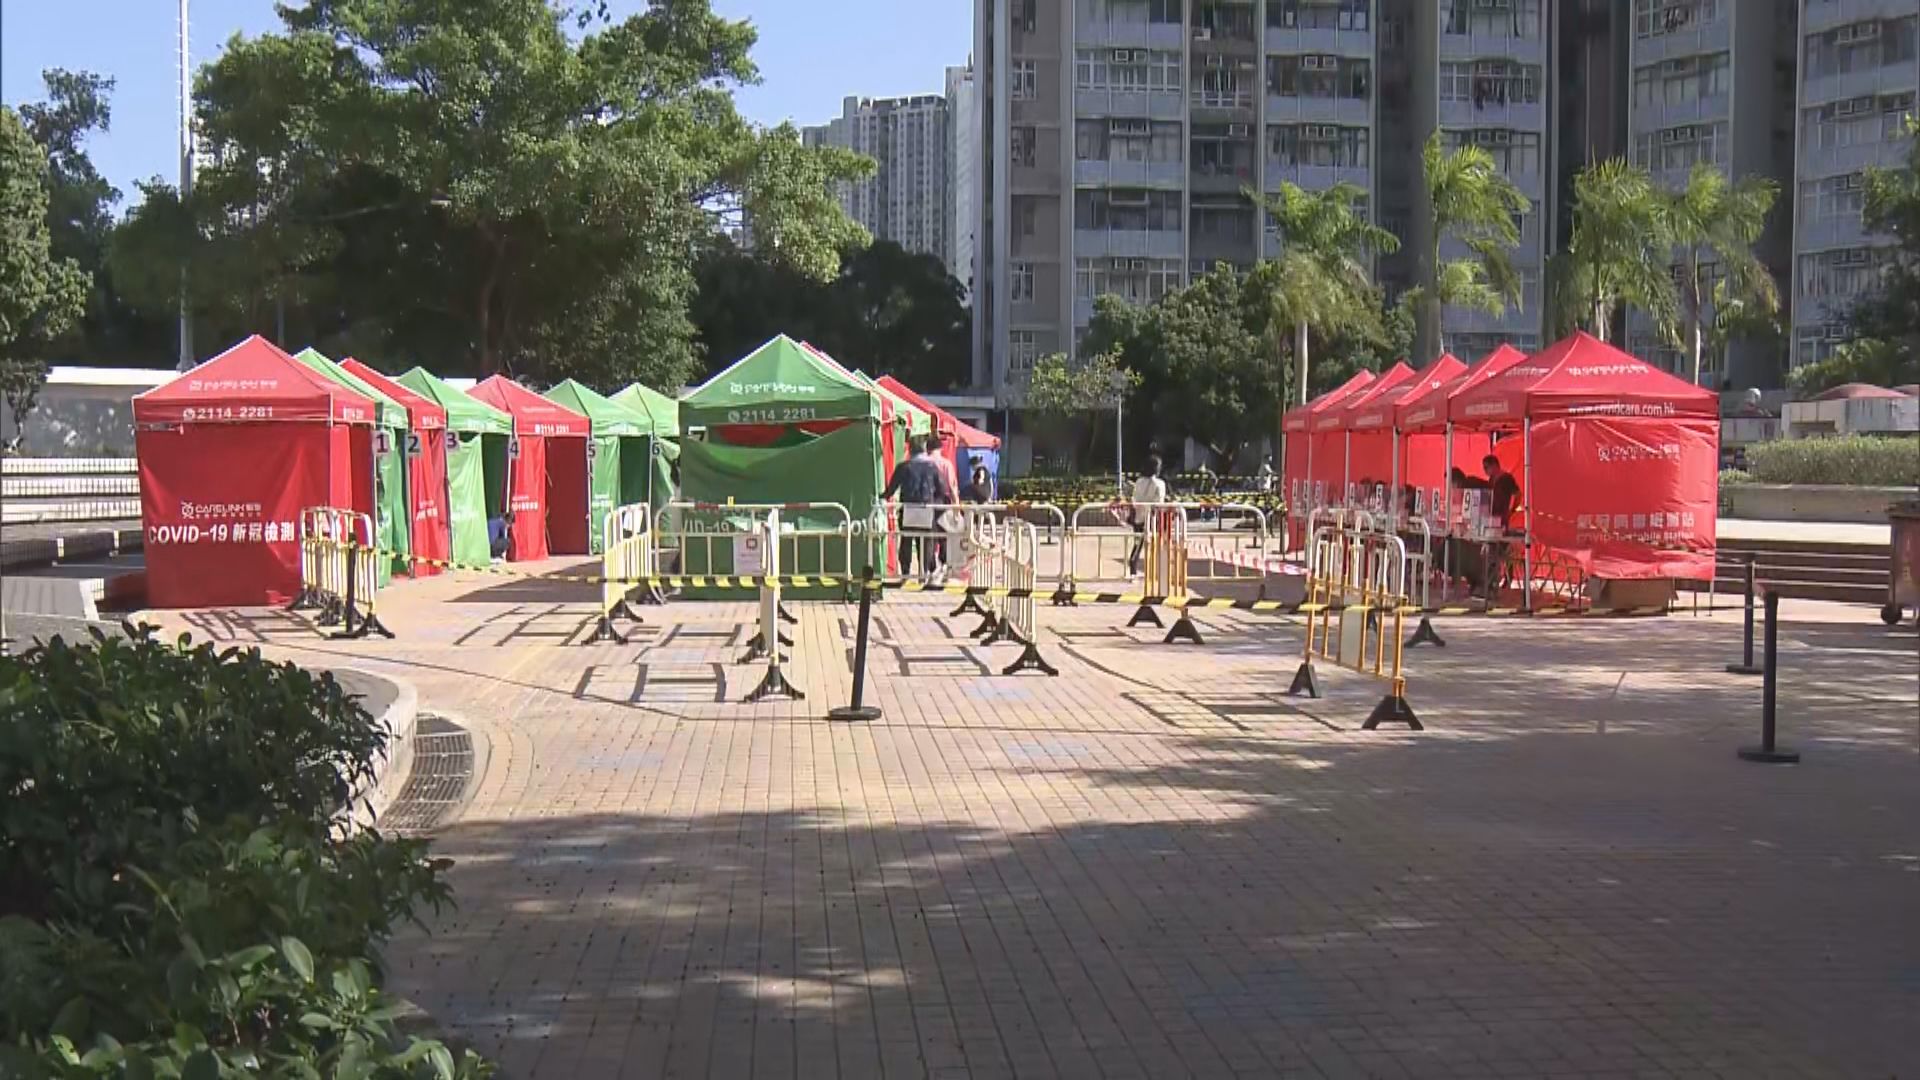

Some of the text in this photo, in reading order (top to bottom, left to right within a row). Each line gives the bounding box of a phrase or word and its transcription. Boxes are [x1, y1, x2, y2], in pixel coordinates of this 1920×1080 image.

[197, 406, 273, 420] 2114 2281
[742, 410, 775, 422] 2114
[376, 434, 389, 453] 1
[408, 435, 420, 453] 2
[447, 432, 457, 448] 3
[510, 445, 519, 456] 4
[588, 444, 596, 457] 5
[148, 520, 295, 544] COVID-19 新冠檢測
